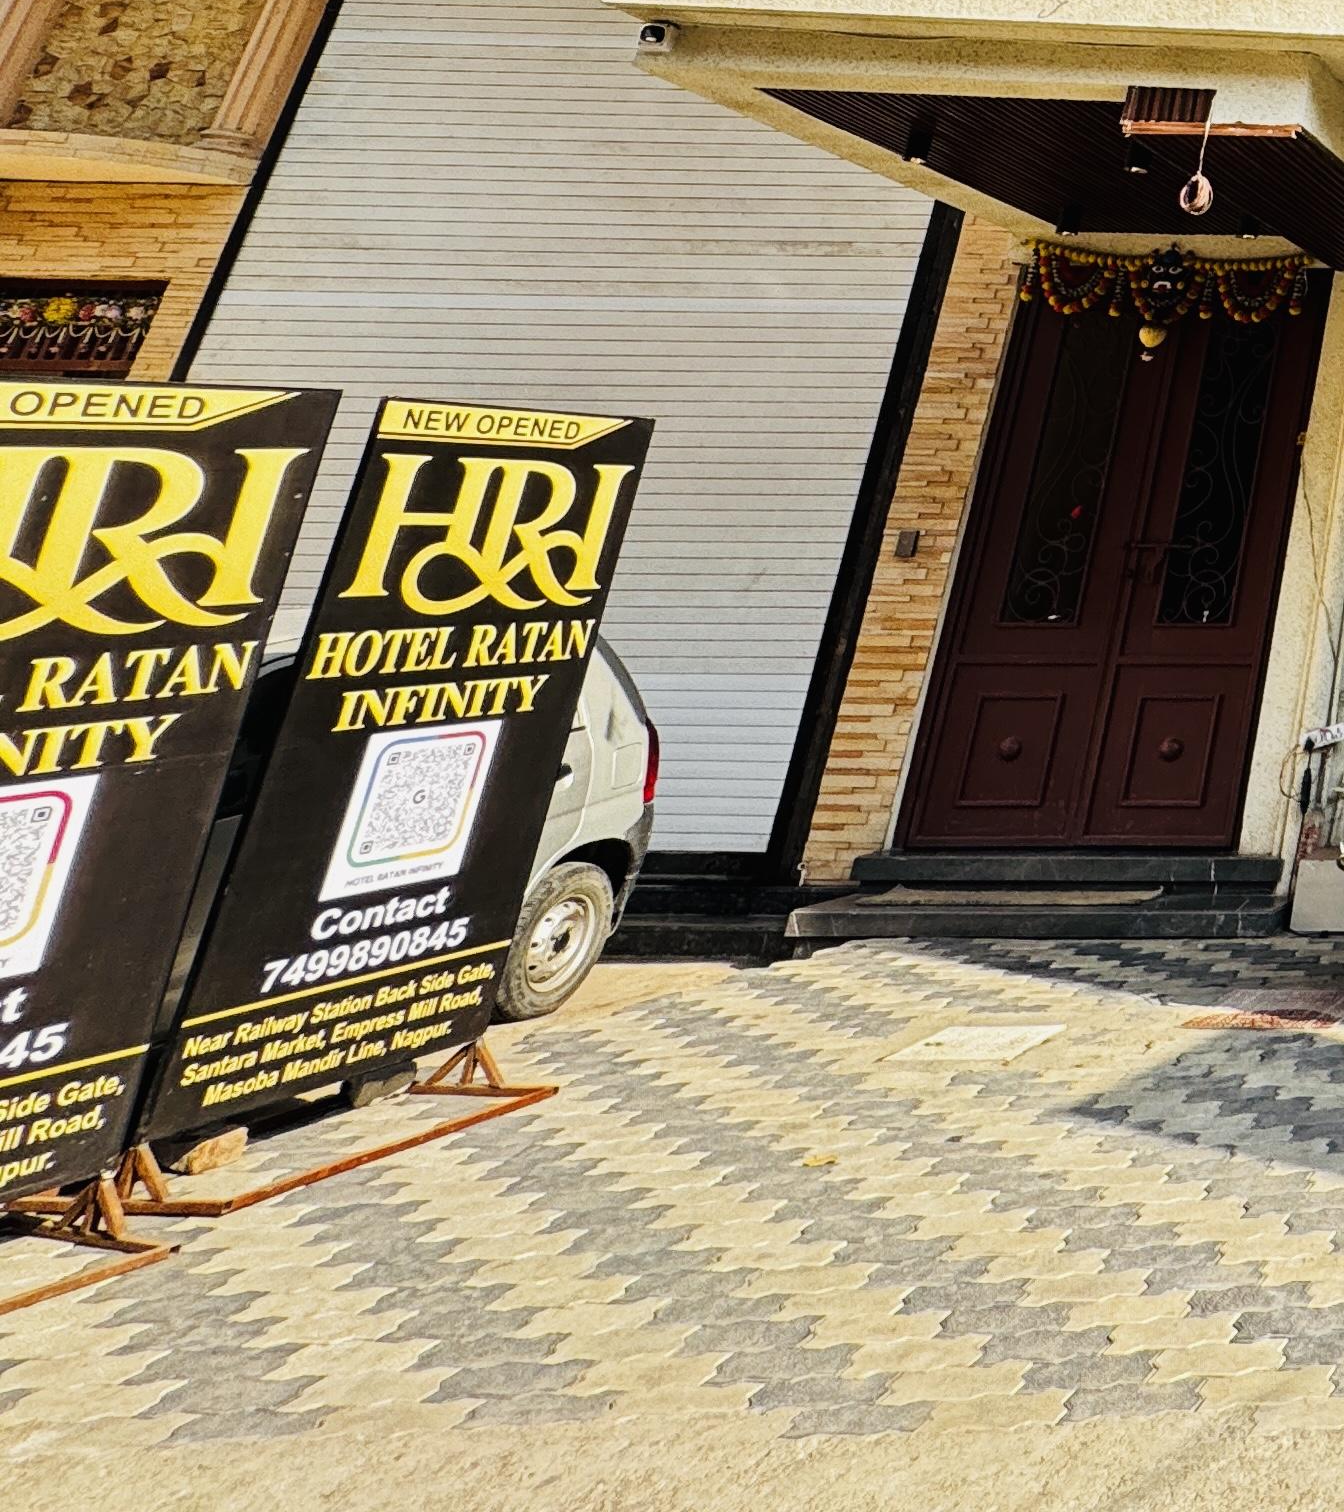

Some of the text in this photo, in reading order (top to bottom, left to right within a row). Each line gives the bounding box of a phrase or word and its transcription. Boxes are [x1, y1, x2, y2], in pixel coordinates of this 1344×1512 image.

[10, 391, 206, 419] OPENED
[403, 409, 580, 438] NEW OPENED
[16, 640, 260, 713] RATAN
[305, 619, 595, 680] HOTEL RATAN
[331, 674, 550, 732] INFINITY
[310, 886, 450, 940] Contact
[260, 917, 469, 993] 7499890845
[180, 986, 482, 1086] Santara Market, Empress Mill Road,
[182, 960, 495, 1059] Near Railway Station Back Side Gate,
[57, 1075, 126, 1107] Gate,
[202, 1020, 452, 1106] Masoba Mandir Line, Nagpur.
[26, 1104, 107, 1145] Road,
